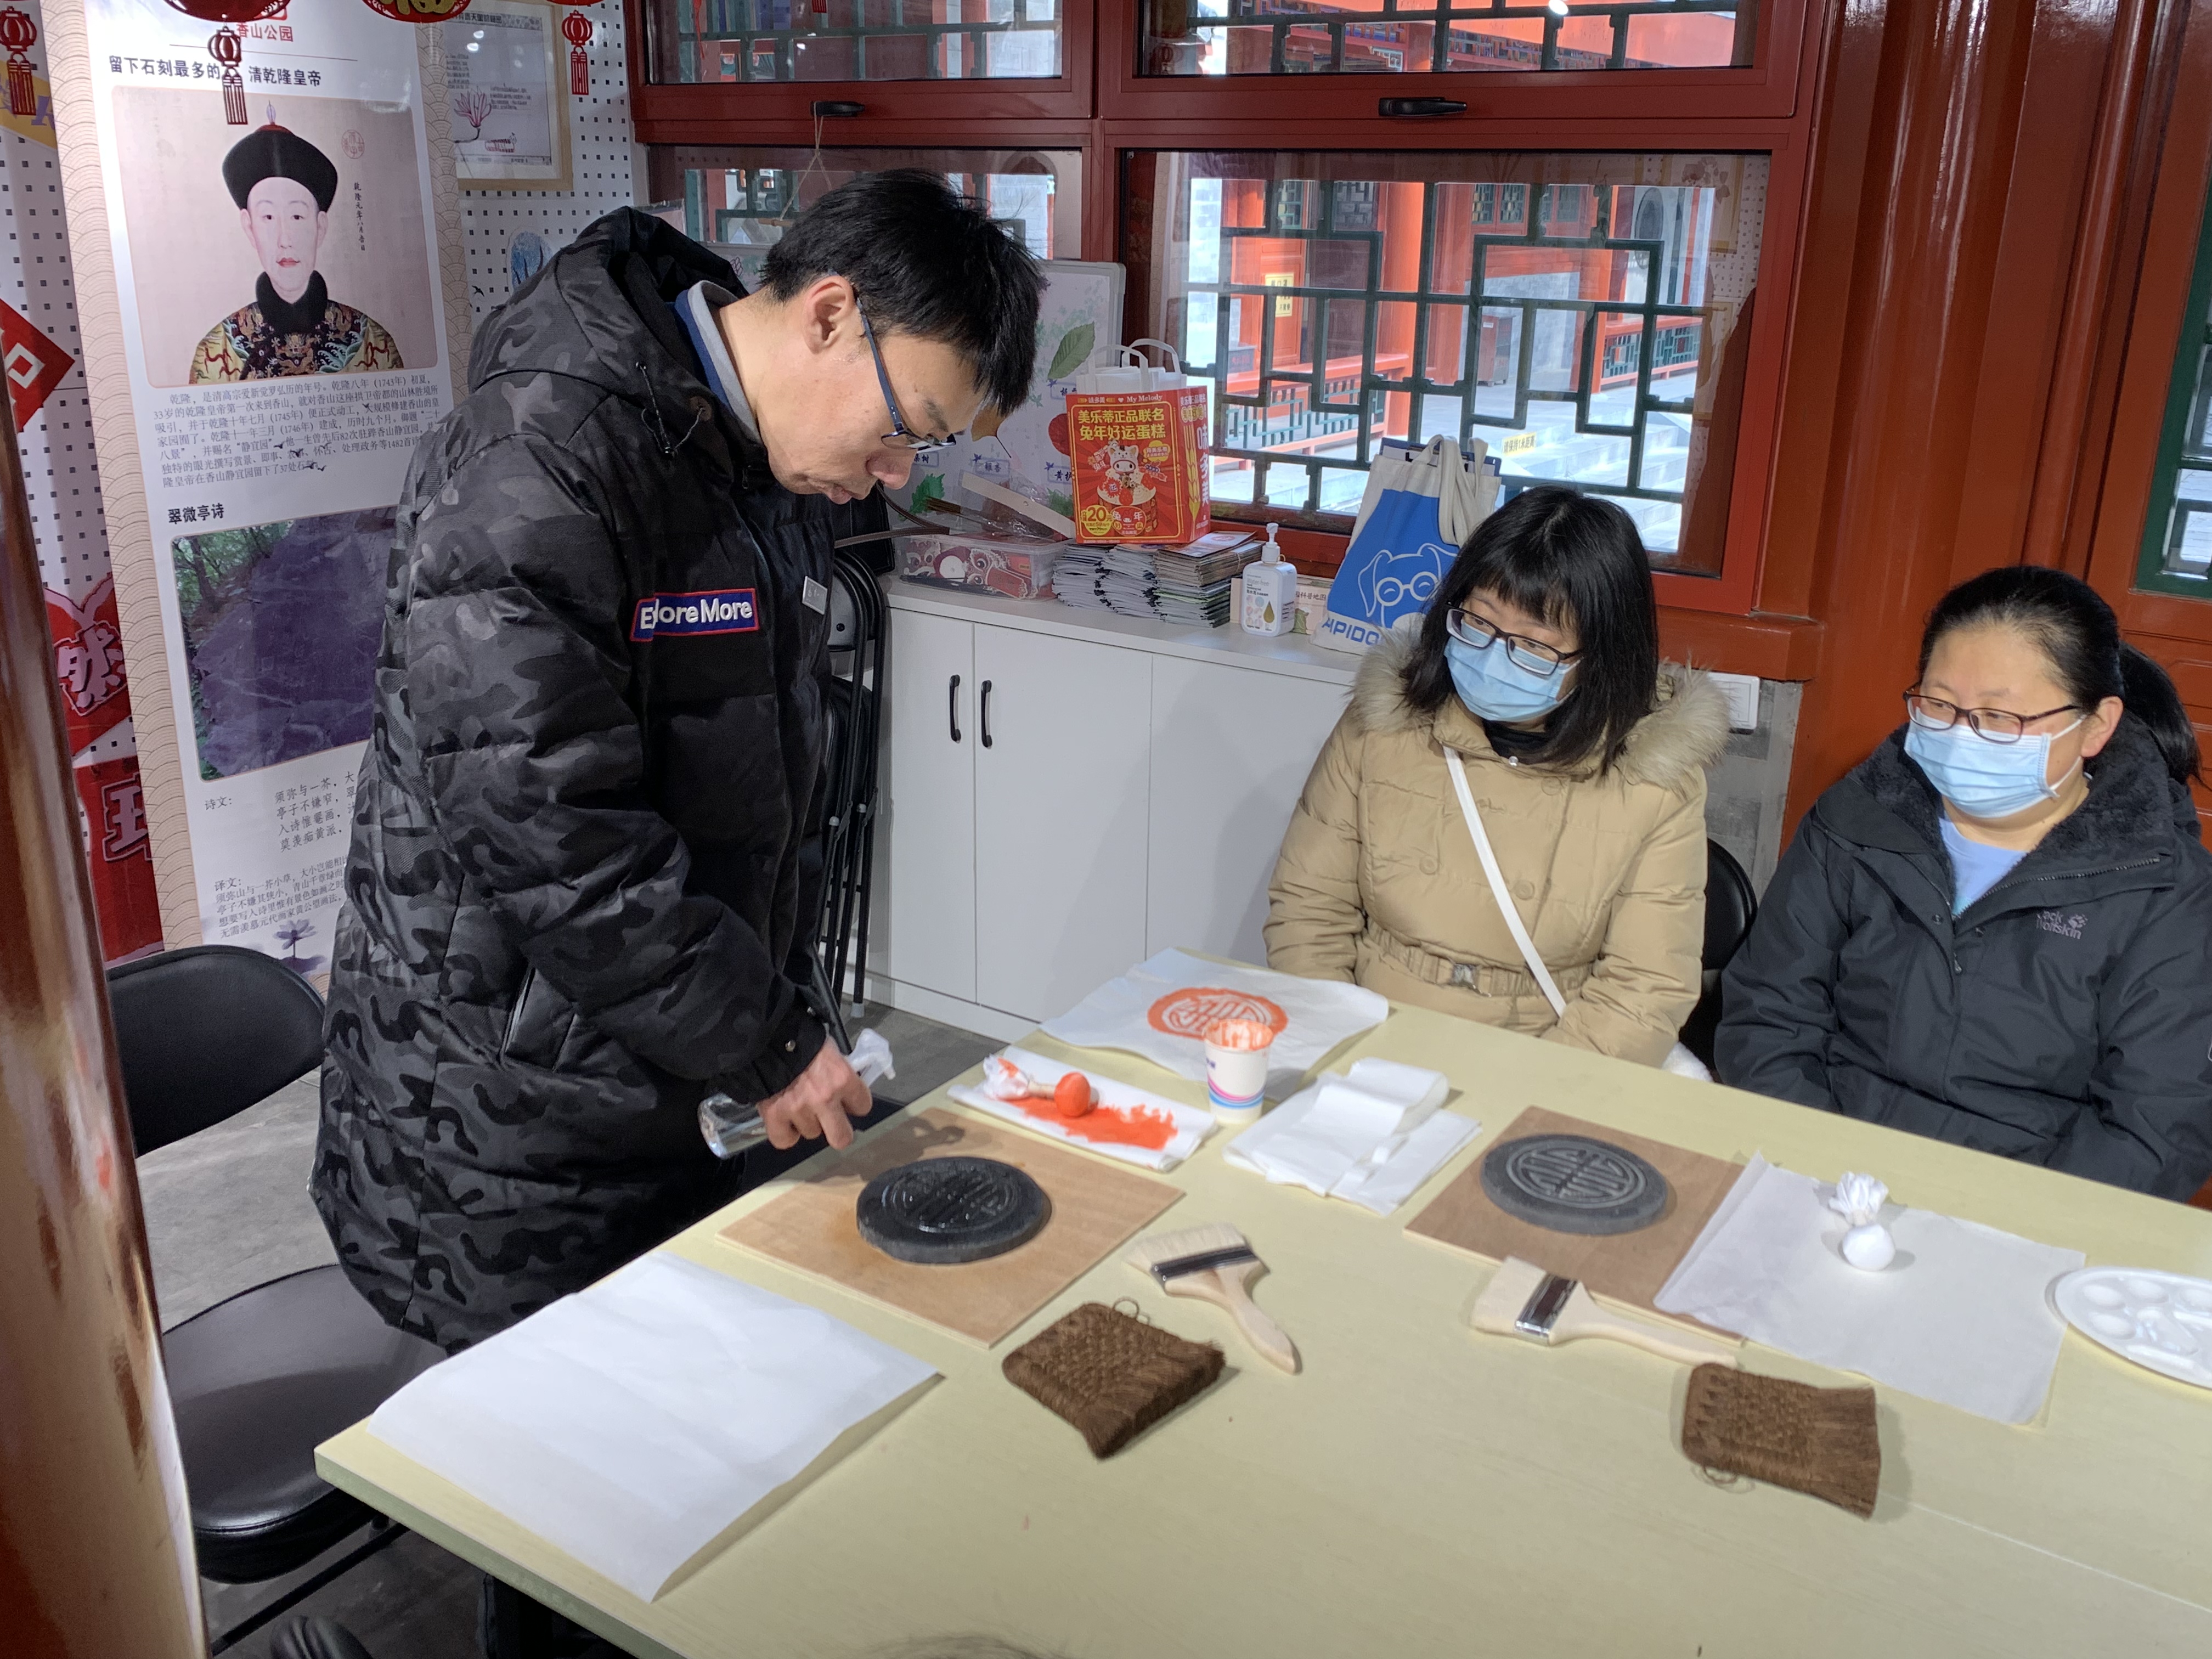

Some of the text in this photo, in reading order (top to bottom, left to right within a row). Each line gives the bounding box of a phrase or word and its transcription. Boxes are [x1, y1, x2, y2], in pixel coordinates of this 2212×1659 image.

[236, 22, 294, 42] 香山公园
[109, 55, 321, 87] 留下石刻最多的 清乾隆皇帝
[1078, 408, 1165, 424] 美乐蒂正品联名
[1080, 423, 1166, 441] 兔年好运蛋糕
[167, 503, 225, 525] 翠微亭诗
